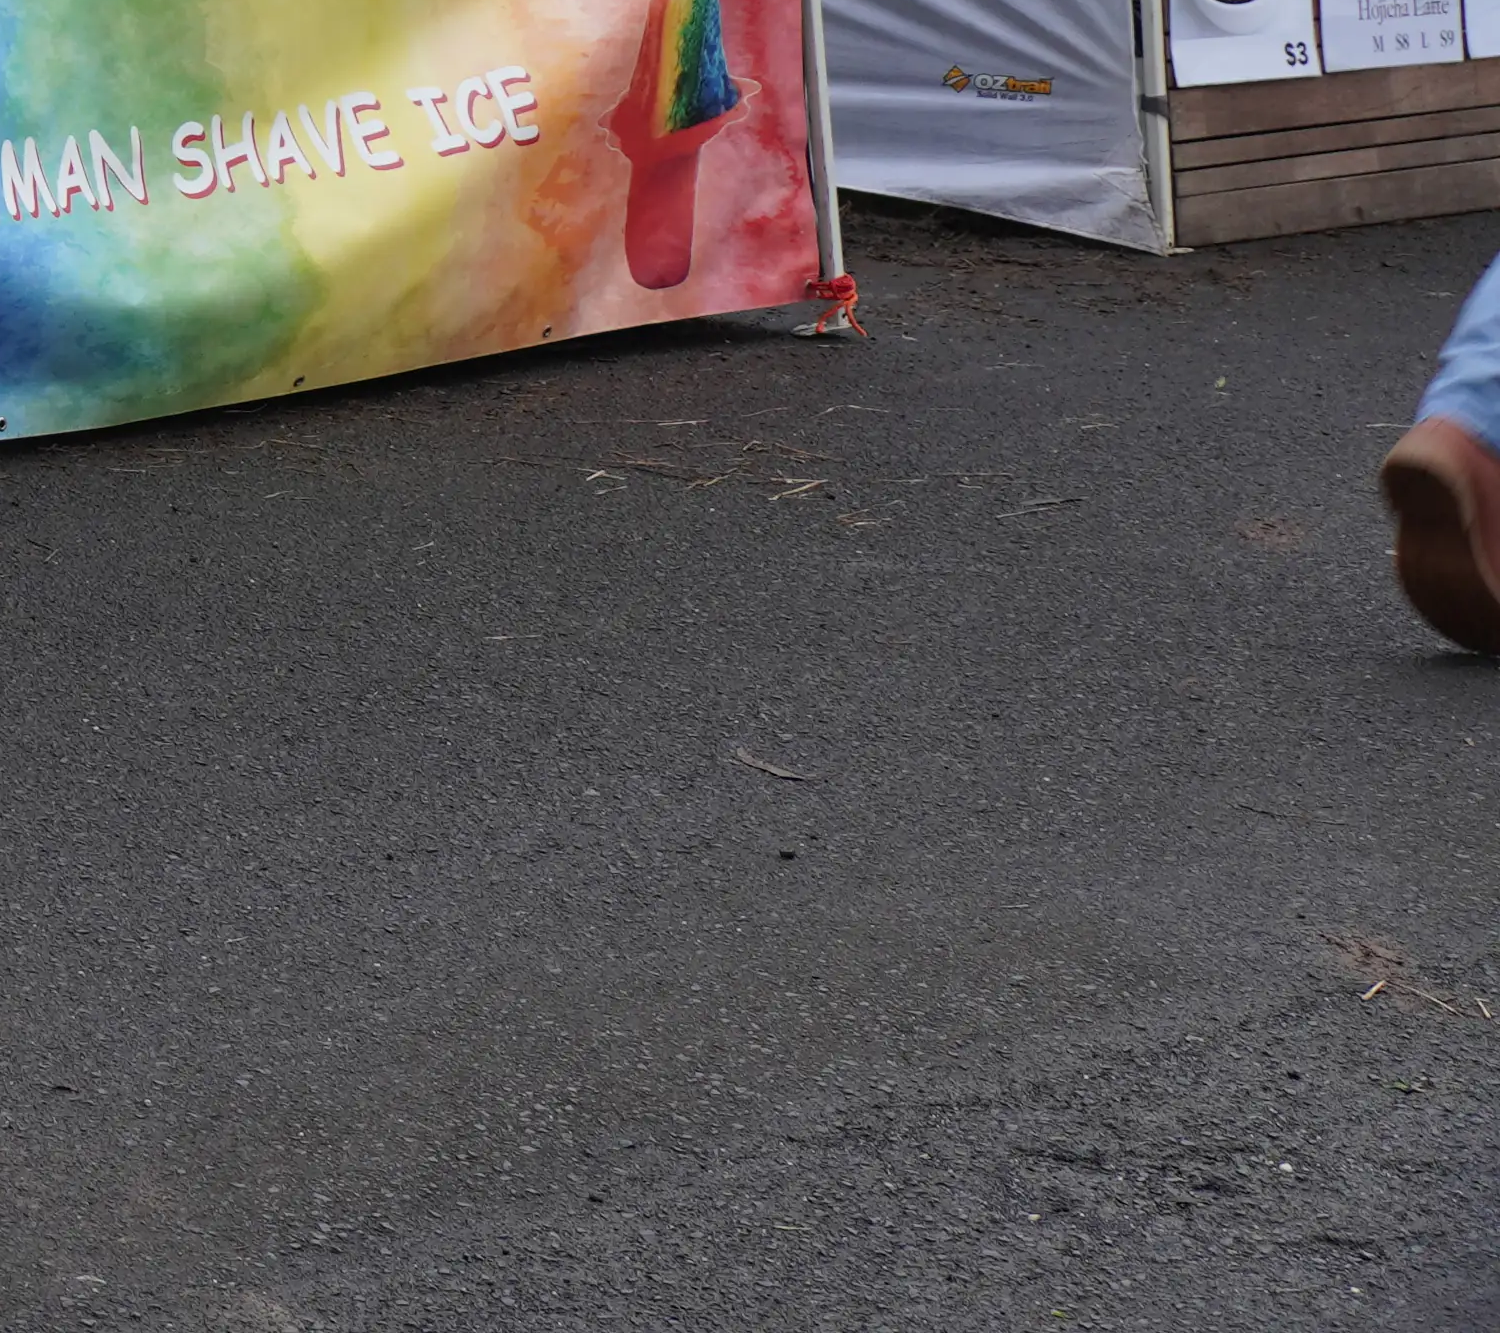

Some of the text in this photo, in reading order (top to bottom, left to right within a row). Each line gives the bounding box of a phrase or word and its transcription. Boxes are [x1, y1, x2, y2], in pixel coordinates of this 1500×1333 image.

[1284, 42, 1309, 67] $3
[1373, 35, 1385, 53] M
[1421, 32, 1429, 50] L
[171, 90, 401, 201] SHAVE
[416, 65, 541, 159] ICE
